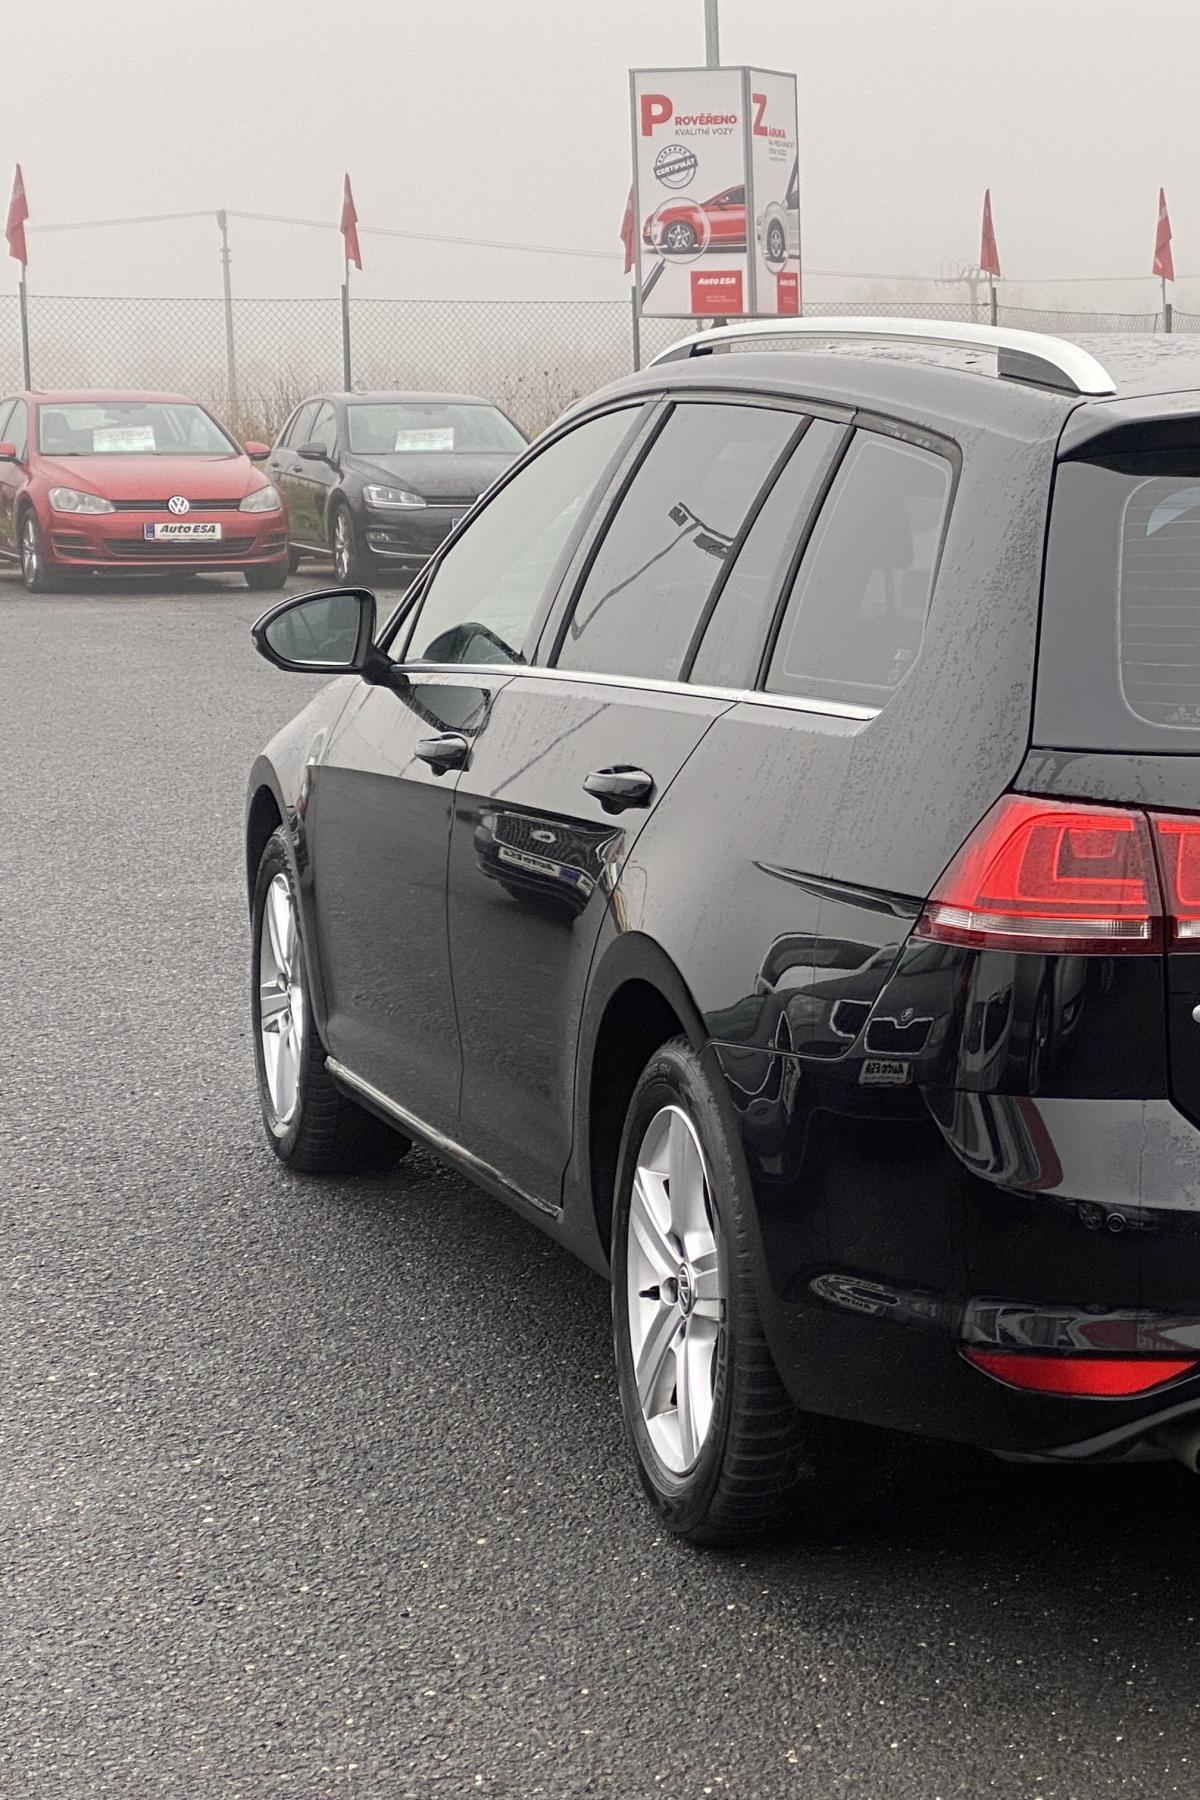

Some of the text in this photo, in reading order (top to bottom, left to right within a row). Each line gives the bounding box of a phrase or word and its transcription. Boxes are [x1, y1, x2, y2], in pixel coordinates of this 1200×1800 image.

[674, 128, 710, 136] KVALITNÍ
[697, 277, 736, 286] Auto ESA
[160, 525, 216, 533] Auto ESA
